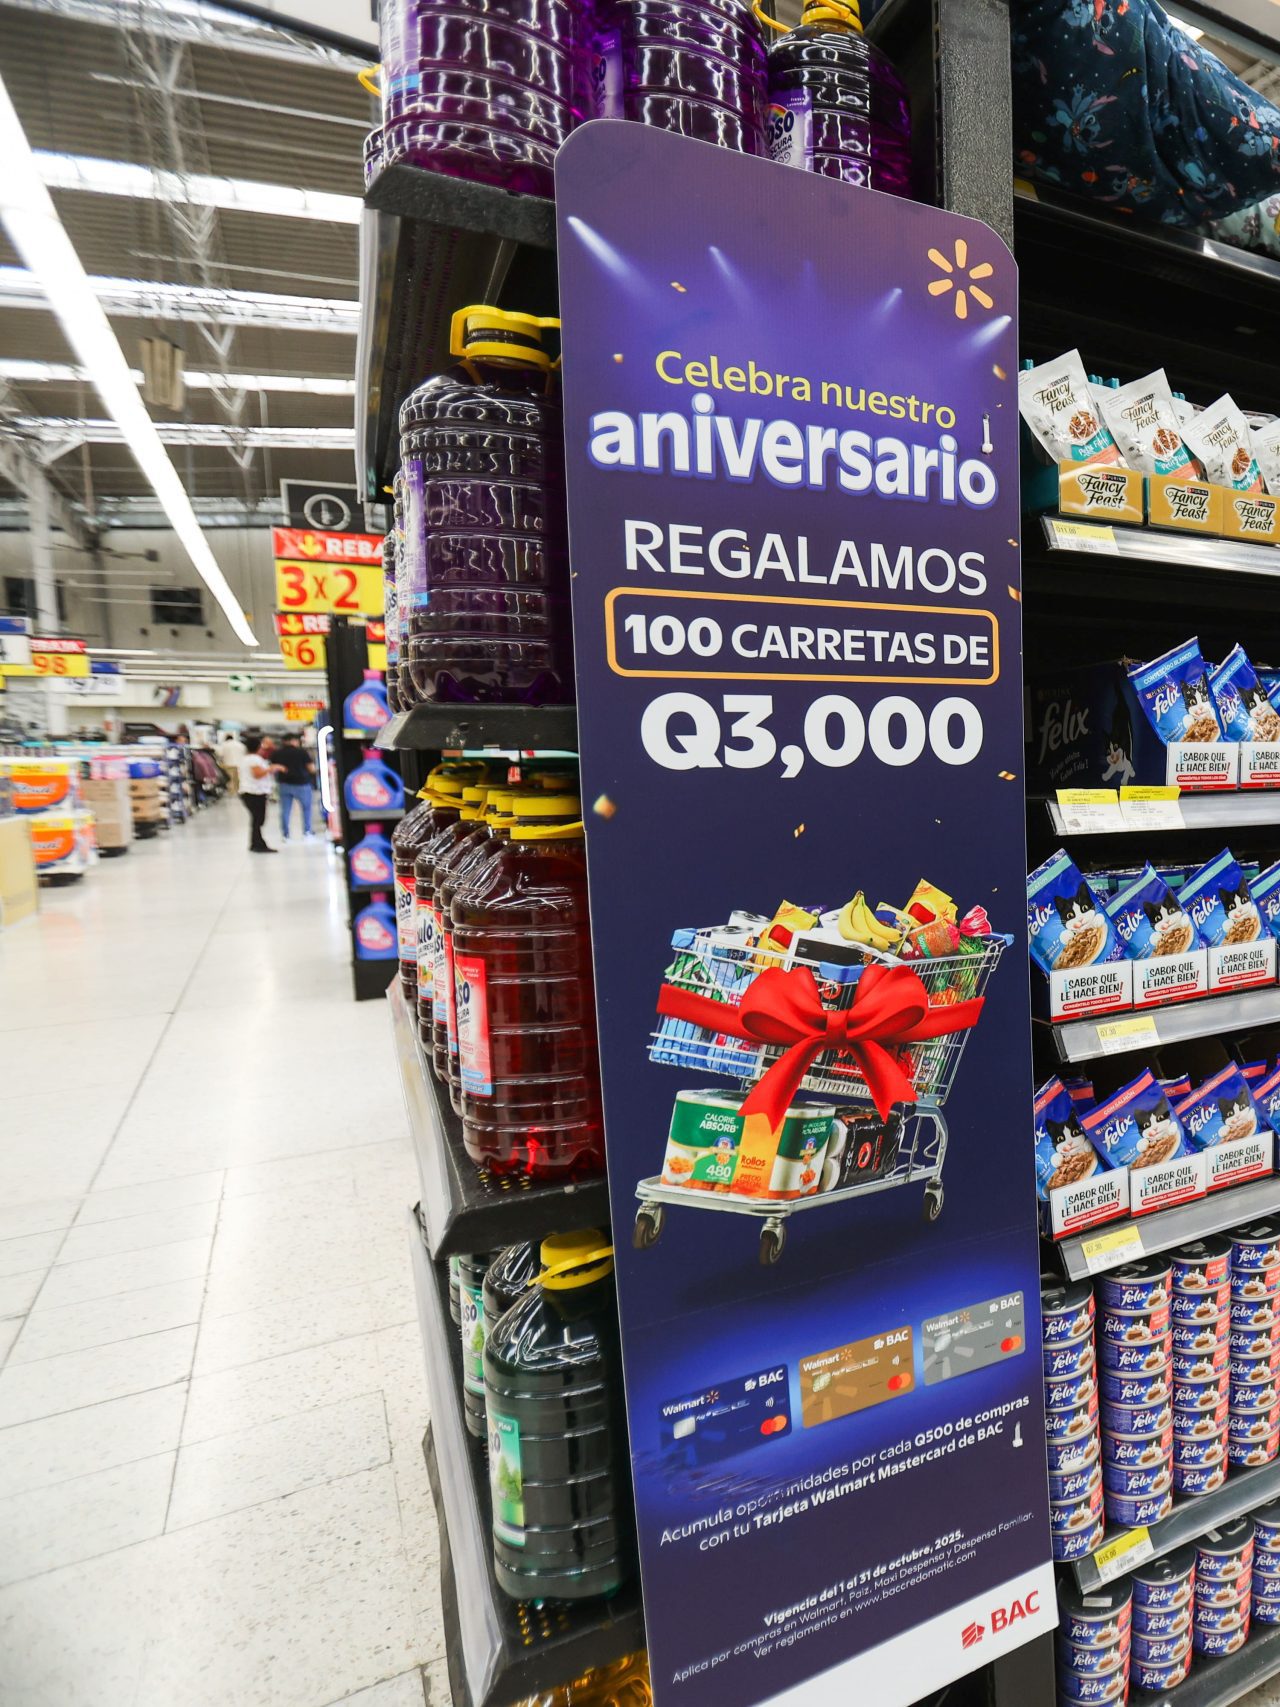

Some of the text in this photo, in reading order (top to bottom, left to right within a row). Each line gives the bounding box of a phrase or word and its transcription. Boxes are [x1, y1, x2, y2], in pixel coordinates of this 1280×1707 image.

[655, 350, 956, 429] Celebra nuestro
[1033, 381, 1070, 406] Fancy
[1044, 393, 1077, 415] Feast
[1121, 399, 1154, 421] Fancy
[1133, 410, 1160, 432] Feast
[591, 393, 997, 505] aniversario
[1078, 473, 1125, 497] Fancy
[1086, 491, 1125, 509] Feast
[1166, 487, 1207, 507] Fancy
[1173, 503, 1207, 520] Feast
[1234, 500, 1274, 520] Fancy
[1242, 516, 1273, 532] Feast
[624, 519, 988, 596] REGALAMOS
[281, 566, 307, 606] 3
[333, 569, 359, 609] 2
[624, 614, 989, 666] 100 CARRETAS DE
[640, 691, 984, 778] Q3,000
[1038, 700, 1089, 765] felix
[1211, 752, 1226, 761] QUE
[1249, 762, 1258, 770] LE
[1259, 761, 1278, 770] HACE
[1176, 762, 1230, 774] LE HACE BIEN!
[1179, 962, 1194, 971] QUE
[1100, 973, 1117, 982] QUE
[1142, 971, 1199, 989] LE HACE BIEN!
[1061, 982, 1123, 1001] LE HACE BIEN!
[699, 1120, 737, 1134] ABSORB
[704, 1112, 736, 1124] CALORIE
[1189, 1104, 1217, 1136] felix
[1102, 1115, 1134, 1152] felix
[706, 1164, 731, 1178] 480
[740, 1155, 766, 1167] Rollos
[1176, 1166, 1192, 1175] QUE
[1099, 1181, 1115, 1191] QUE
[1140, 1188, 1149, 1197] LE
[1152, 1181, 1173, 1193] HACE
[1176, 1174, 1197, 1186] BIEN!
[1061, 1207, 1070, 1217] LE
[1074, 1199, 1095, 1213] HACE
[1098, 1189, 1120, 1203] BIEN!
[1000, 1295, 1020, 1311] BAC
[1121, 1288, 1147, 1306] felix
[926, 1315, 959, 1333] Walmart
[1044, 1316, 1072, 1339] felix
[887, 1330, 909, 1346] BAC
[802, 1353, 839, 1372] Walmart
[1052, 1353, 1078, 1372] felix
[759, 1369, 784, 1387] BAC
[663, 1395, 704, 1417] Walmart
[660, 1508, 733, 1546] Acumula
[852, 1453, 877, 1476] por
[879, 1439, 912, 1461] cada
[915, 1422, 953, 1447] Q500
[955, 1416, 972, 1432] de
[975, 1395, 1029, 1424] compras
[700, 1421, 1003, 1551] con tu Tarjeta Walmart Mastercard de BAC
[764, 1530, 964, 1626] Vigencia del 1 al 31 de octubre, 2025.
[672, 1661, 709, 1684] Aplica
[711, 1650, 731, 1667] por
[733, 1628, 782, 1655] compras
[784, 1621, 797, 1632] en
[874, 1573, 898, 1593] Maxi
[900, 1552, 945, 1579] Despensa
[946, 1548, 952, 1559] y
[954, 1528, 996, 1553] Despensa
[998, 1511, 1034, 1533] Familiar.
[753, 1549, 977, 1659] Ver reglamento en www.baccredomatic.com
[1148, 1589, 1173, 1603] felix
[991, 1590, 1040, 1635] BAC
[1071, 1624, 1096, 1638] felix
